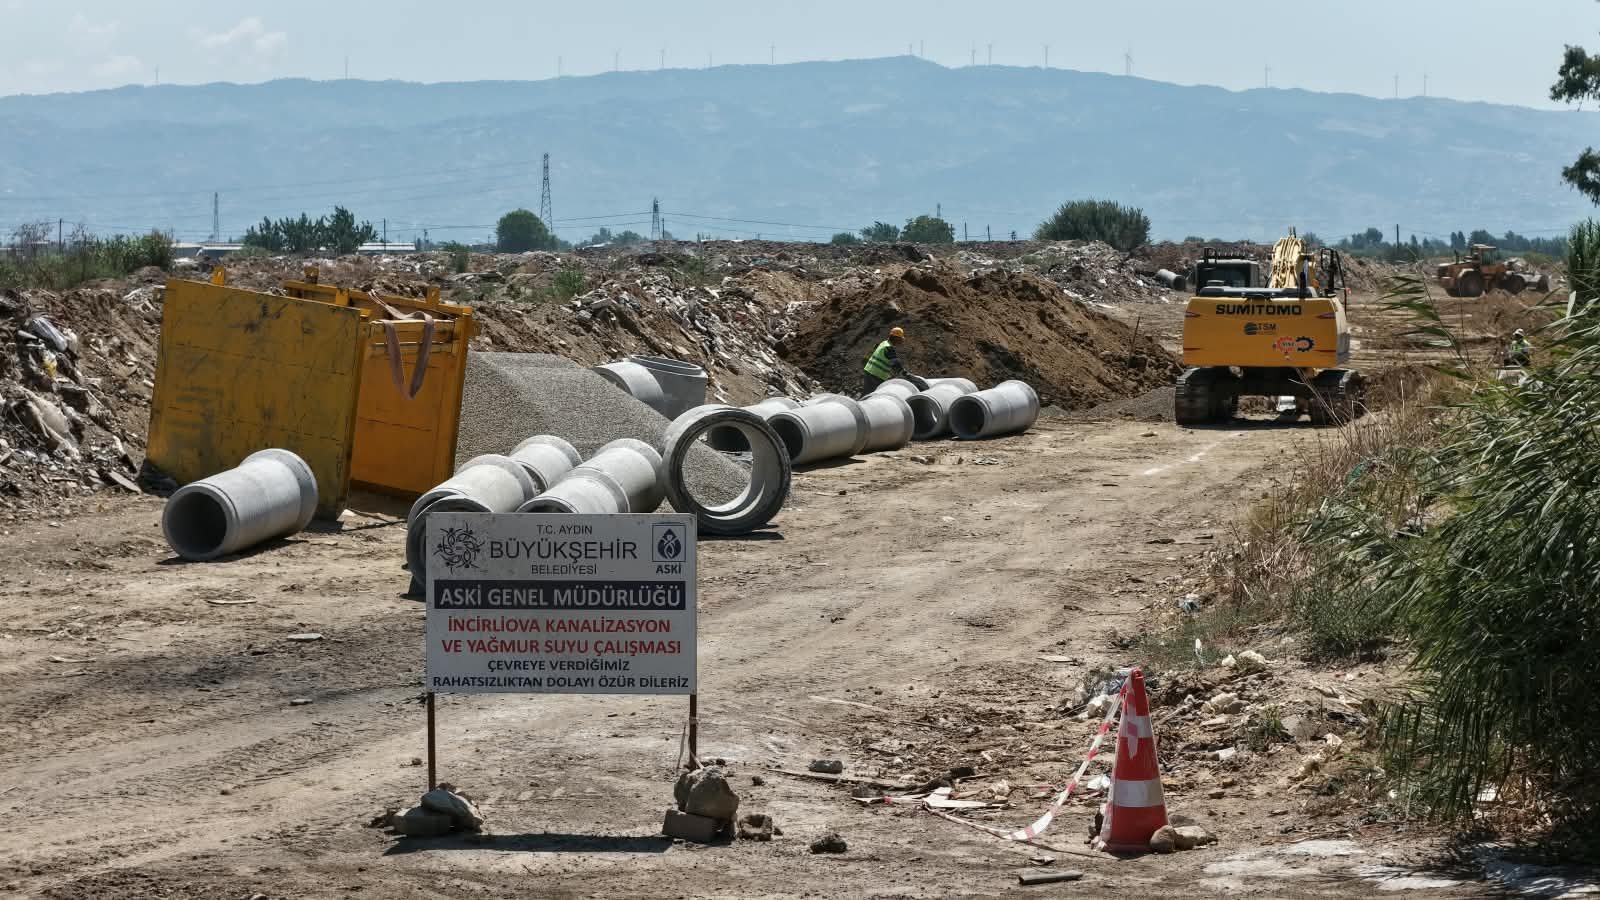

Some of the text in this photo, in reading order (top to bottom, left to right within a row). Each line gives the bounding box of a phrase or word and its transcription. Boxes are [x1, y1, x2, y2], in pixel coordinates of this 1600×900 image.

[1216, 304, 1302, 315] SUMITOMO
[537, 524, 592, 535] T.C. AYDIN
[490, 538, 638, 563] BÜYÜKŞEHİR
[531, 563, 597, 575] BELEDİYESİ
[656, 563, 681, 574] ASKİ
[440, 584, 680, 606] ASKİ GENEL MÜDÜRLÜĞÜ
[448, 616, 670, 633] İNCİRLİOVA KANALİZASYON
[442, 637, 681, 656] VE YAĞMUR SUYU ÇALIŞMASI
[488, 658, 630, 672] ÇEVREYE VERDİĞİMİZ
[433, 676, 689, 688] RAHATSIZLIKTAN DOLAYI ÖZÜR DİLERİZ
